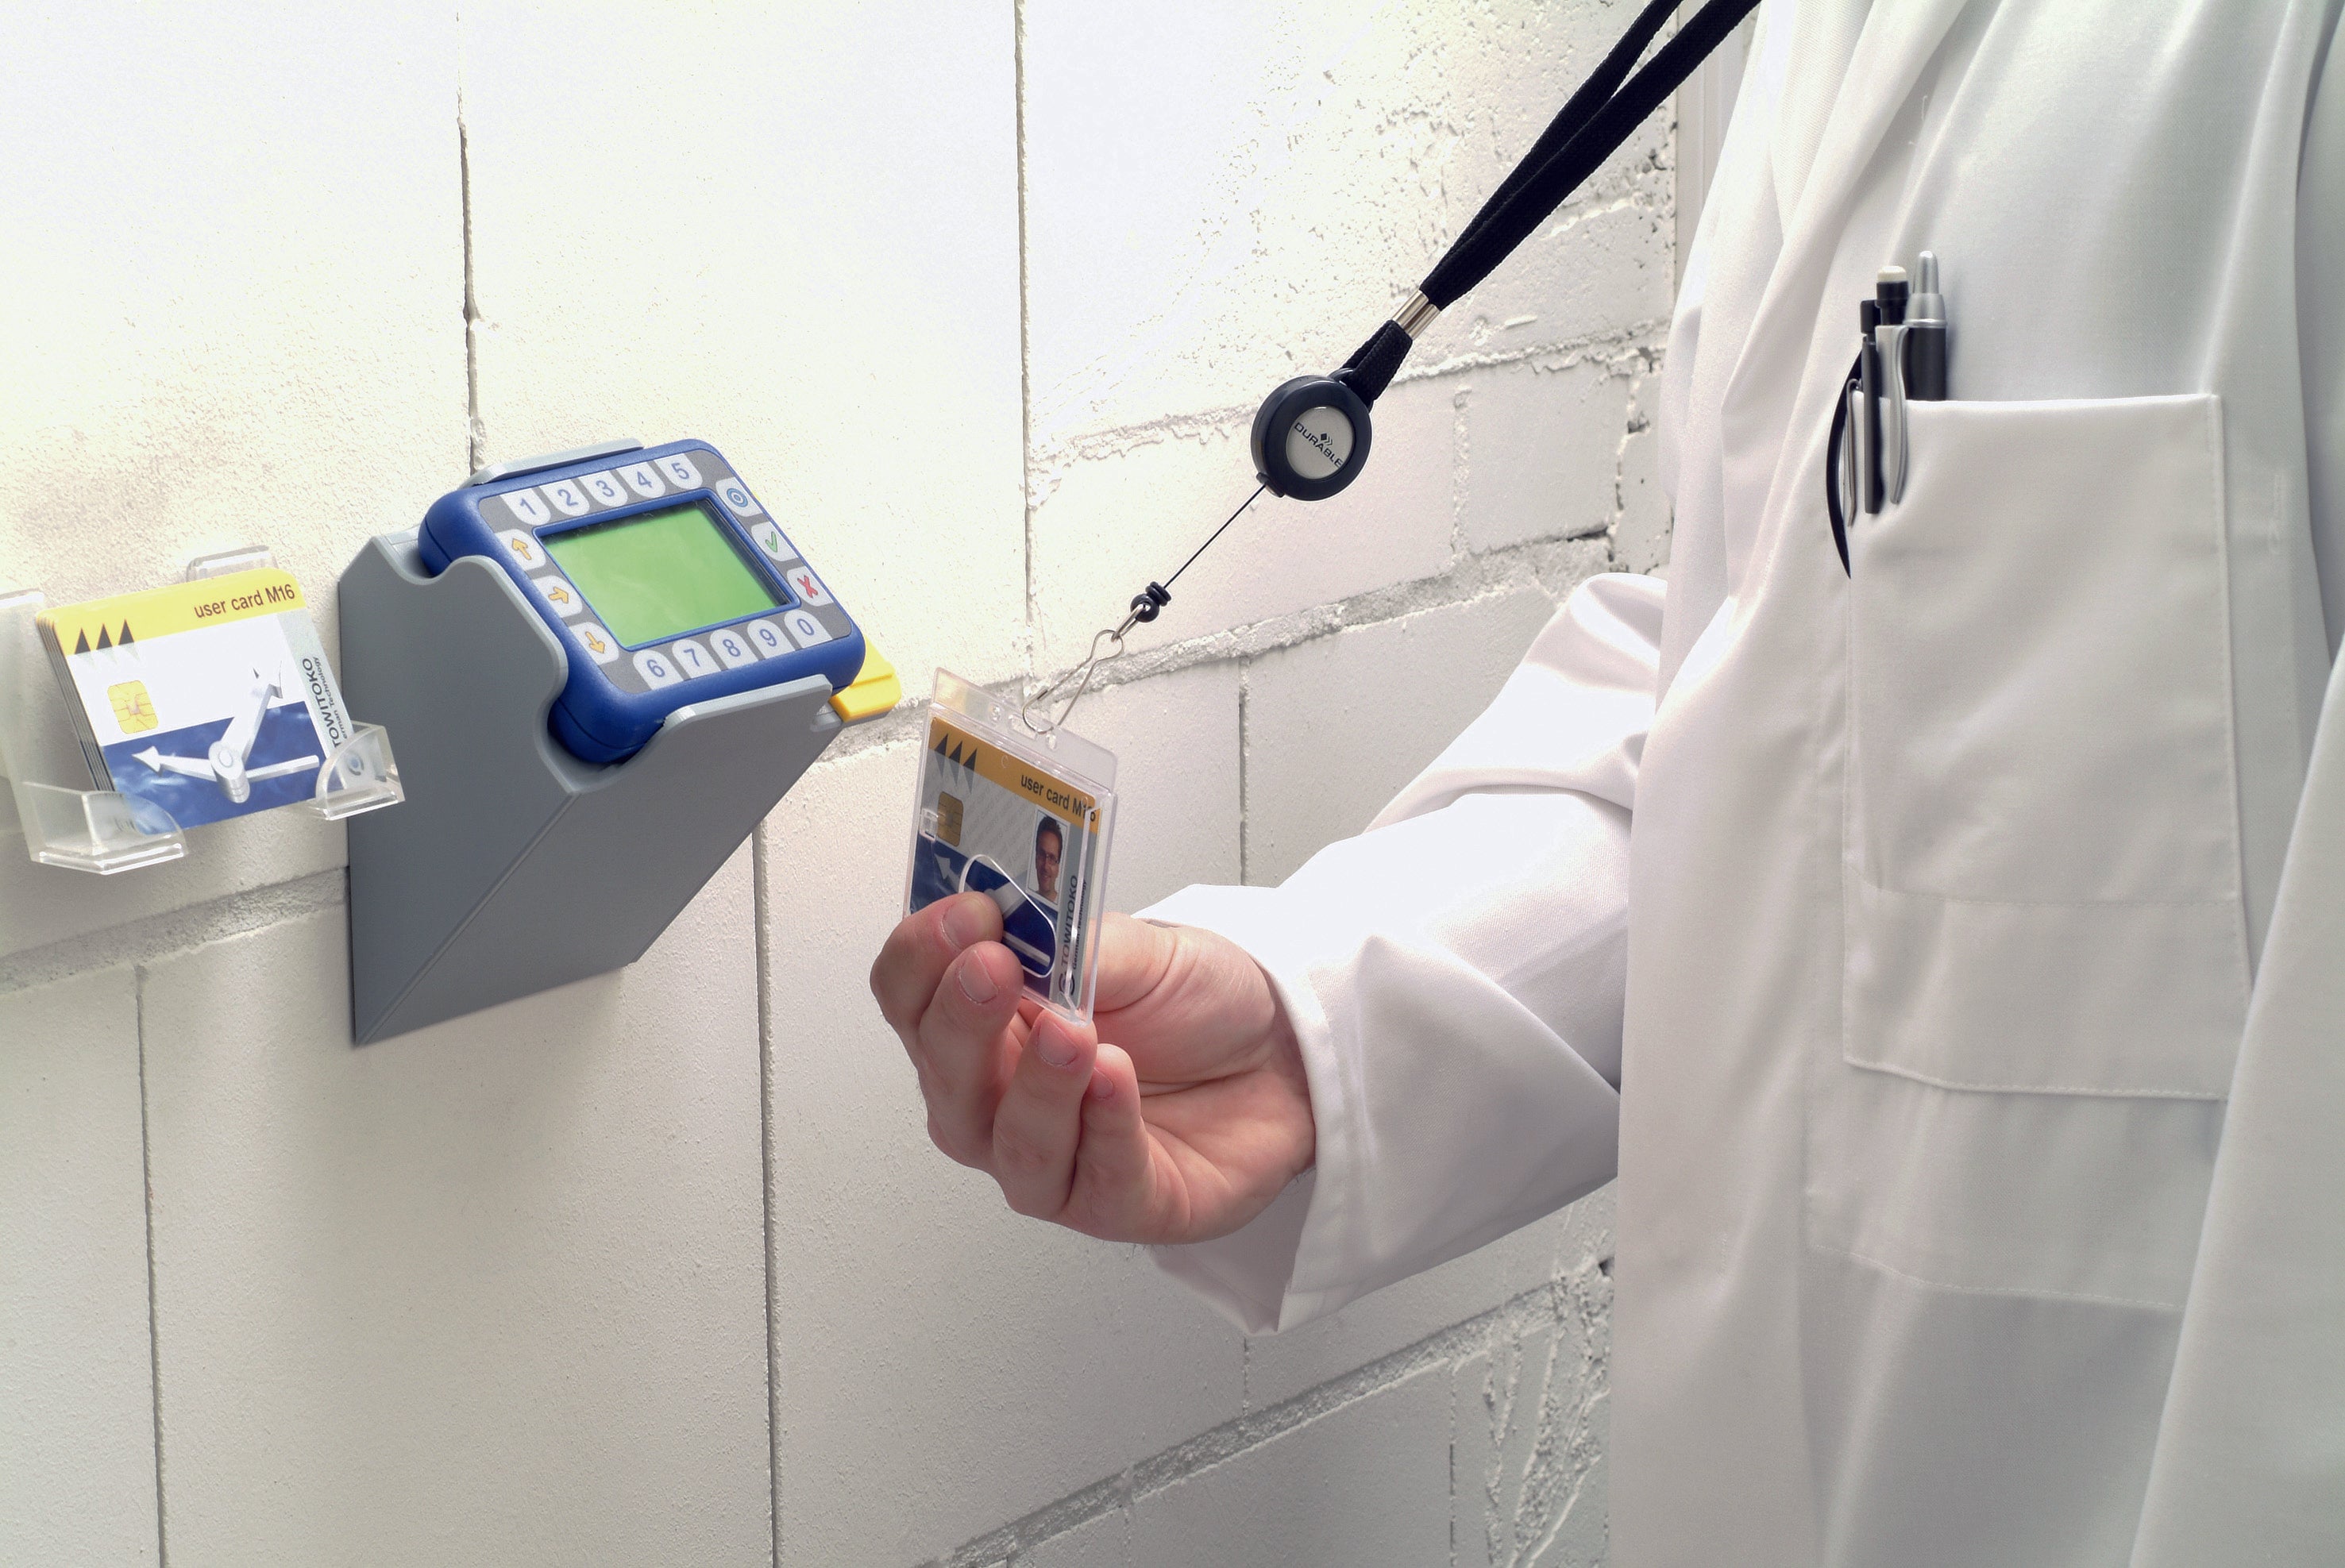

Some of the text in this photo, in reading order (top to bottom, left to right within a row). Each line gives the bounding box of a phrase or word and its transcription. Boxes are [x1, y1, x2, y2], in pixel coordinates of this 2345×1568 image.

[1294, 422, 1344, 468] DURABLE
[519, 462, 690, 517] 1 2 3 4 5
[194, 584, 295, 618] user card M16
[646, 618, 816, 679] 6 7 8 9 0
[302, 658, 341, 748] TOWITOKO
[313, 656, 335, 707] Technology
[1020, 774, 1044, 796] user
[1046, 788, 1070, 811] card
[1061, 875, 1078, 967] TOWITOKO
